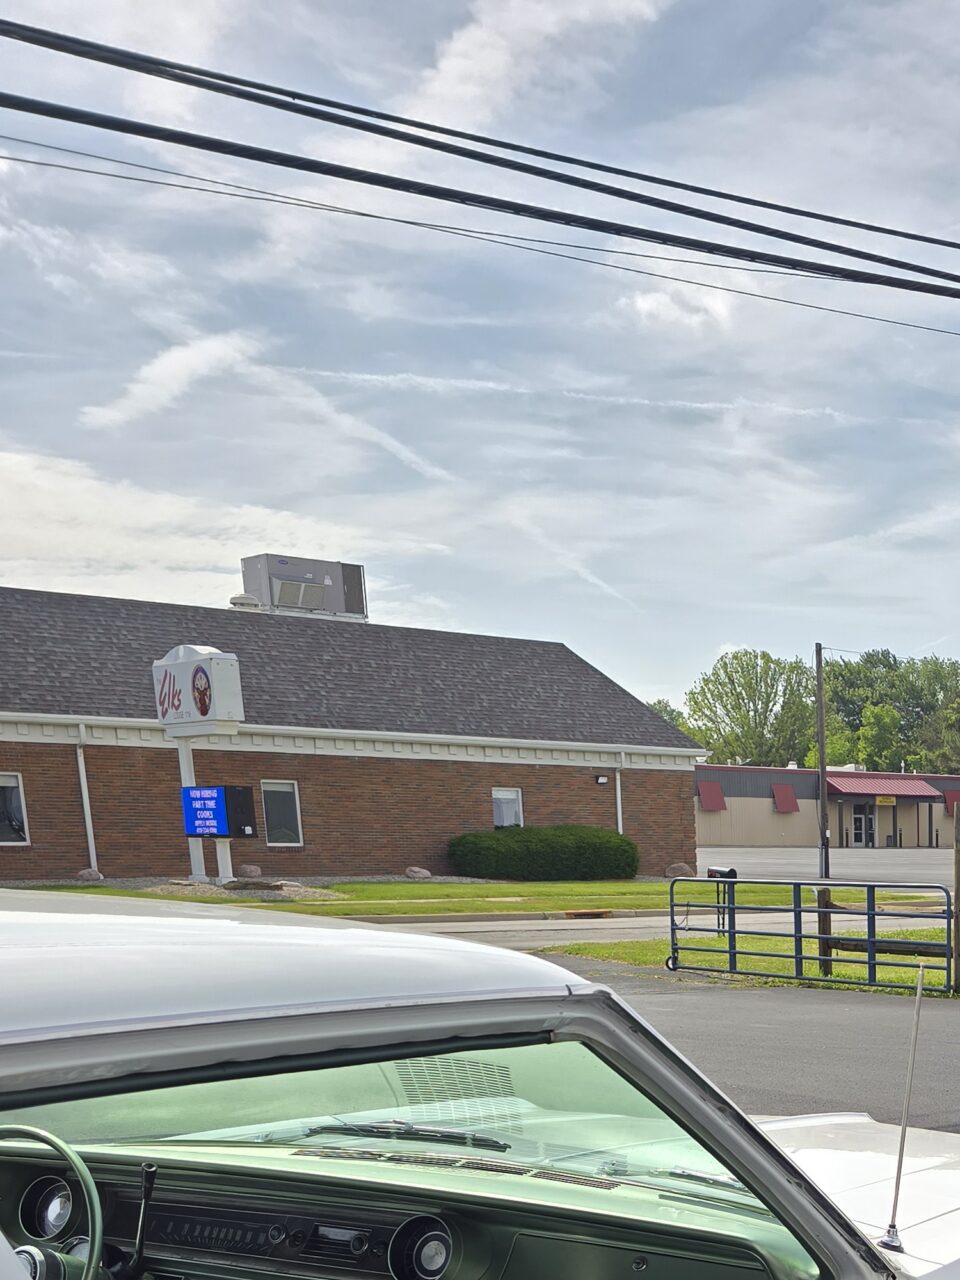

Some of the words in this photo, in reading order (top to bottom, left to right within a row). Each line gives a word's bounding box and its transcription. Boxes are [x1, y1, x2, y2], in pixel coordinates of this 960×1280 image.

[159, 669, 182, 720] Elks
[190, 790, 200, 798] NOW
[205, 800, 216, 808] TIME
